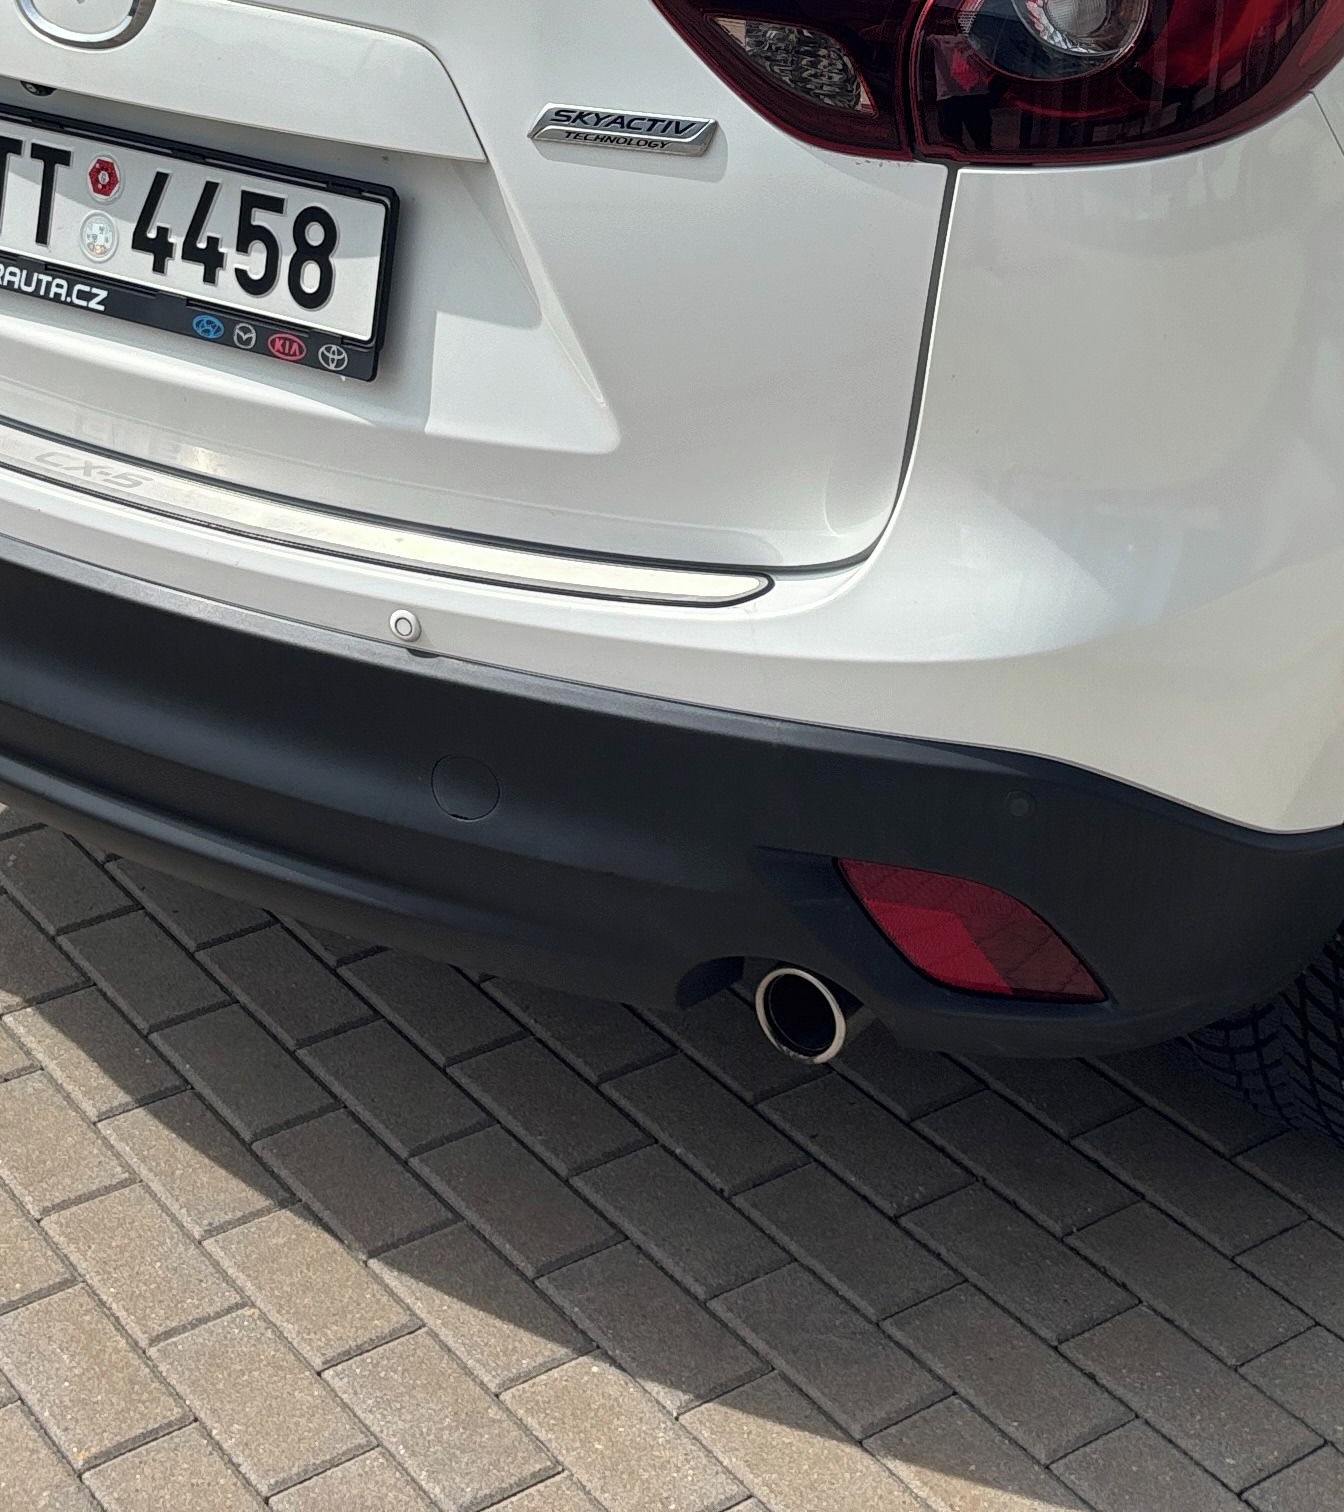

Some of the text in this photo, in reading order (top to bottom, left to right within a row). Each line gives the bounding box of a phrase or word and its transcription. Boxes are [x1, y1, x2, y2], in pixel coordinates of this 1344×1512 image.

[550, 109, 697, 135] SKYACTIV
[564, 131, 669, 149] TECHNOLOGY
[132, 171, 338, 310] 4458
[274, 339, 300, 357] KIA
[34, 451, 154, 489] CX-5
